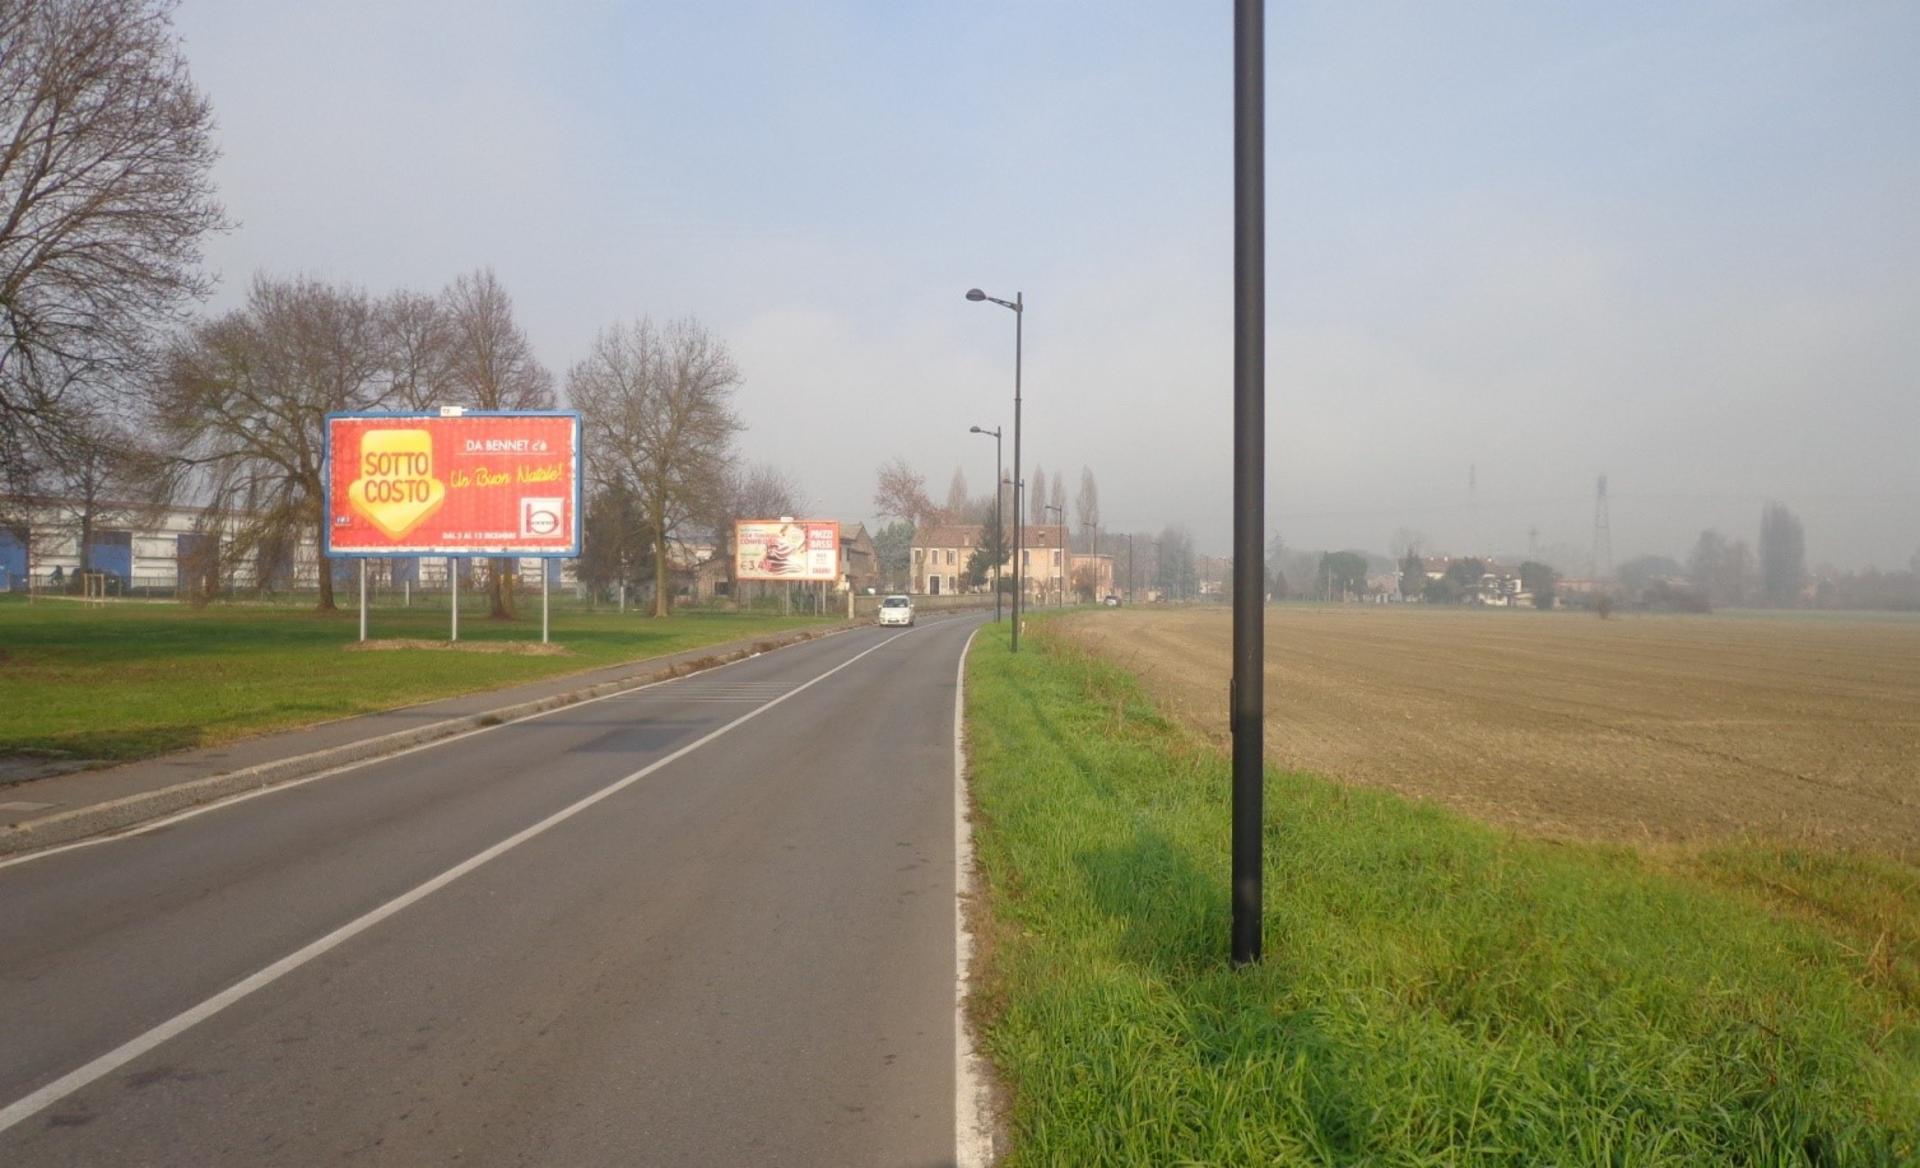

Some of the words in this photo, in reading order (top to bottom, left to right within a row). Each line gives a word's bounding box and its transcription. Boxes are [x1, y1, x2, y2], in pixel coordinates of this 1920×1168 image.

[465, 439, 483, 452] DA
[485, 439, 529, 452] BENNET
[364, 452, 429, 477] SOTTO
[450, 469, 471, 488] Un
[475, 466, 510, 487] Buon
[364, 479, 430, 504] COSTO
